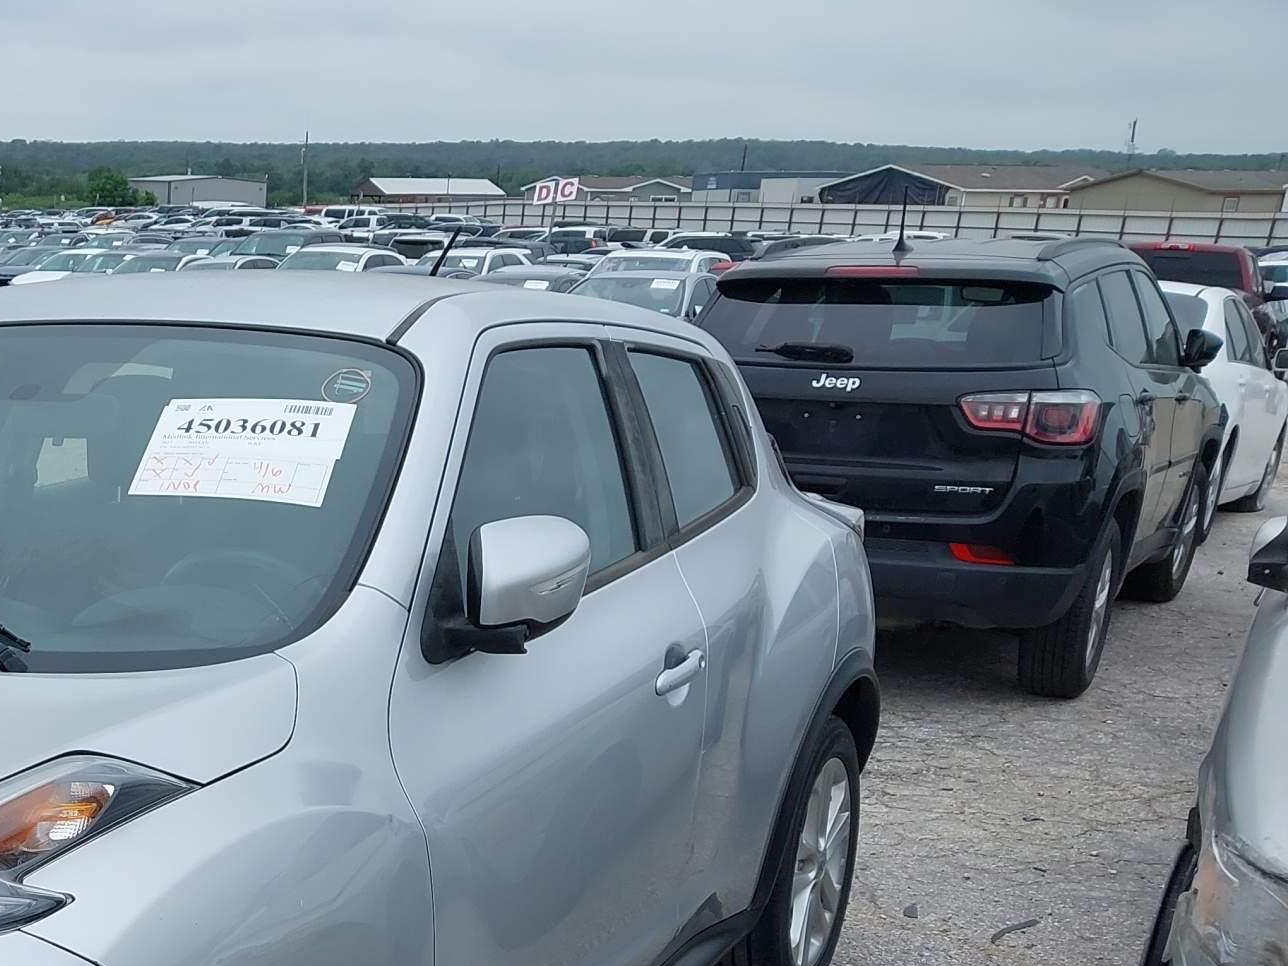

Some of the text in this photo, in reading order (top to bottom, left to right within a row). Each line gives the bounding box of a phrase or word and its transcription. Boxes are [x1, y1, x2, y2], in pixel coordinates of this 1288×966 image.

[537, 185, 551, 202] D
[560, 181, 575, 198] C
[812, 373, 861, 392] Jeep
[176, 417, 321, 438] 45036081
[934, 485, 994, 494] SPORT
